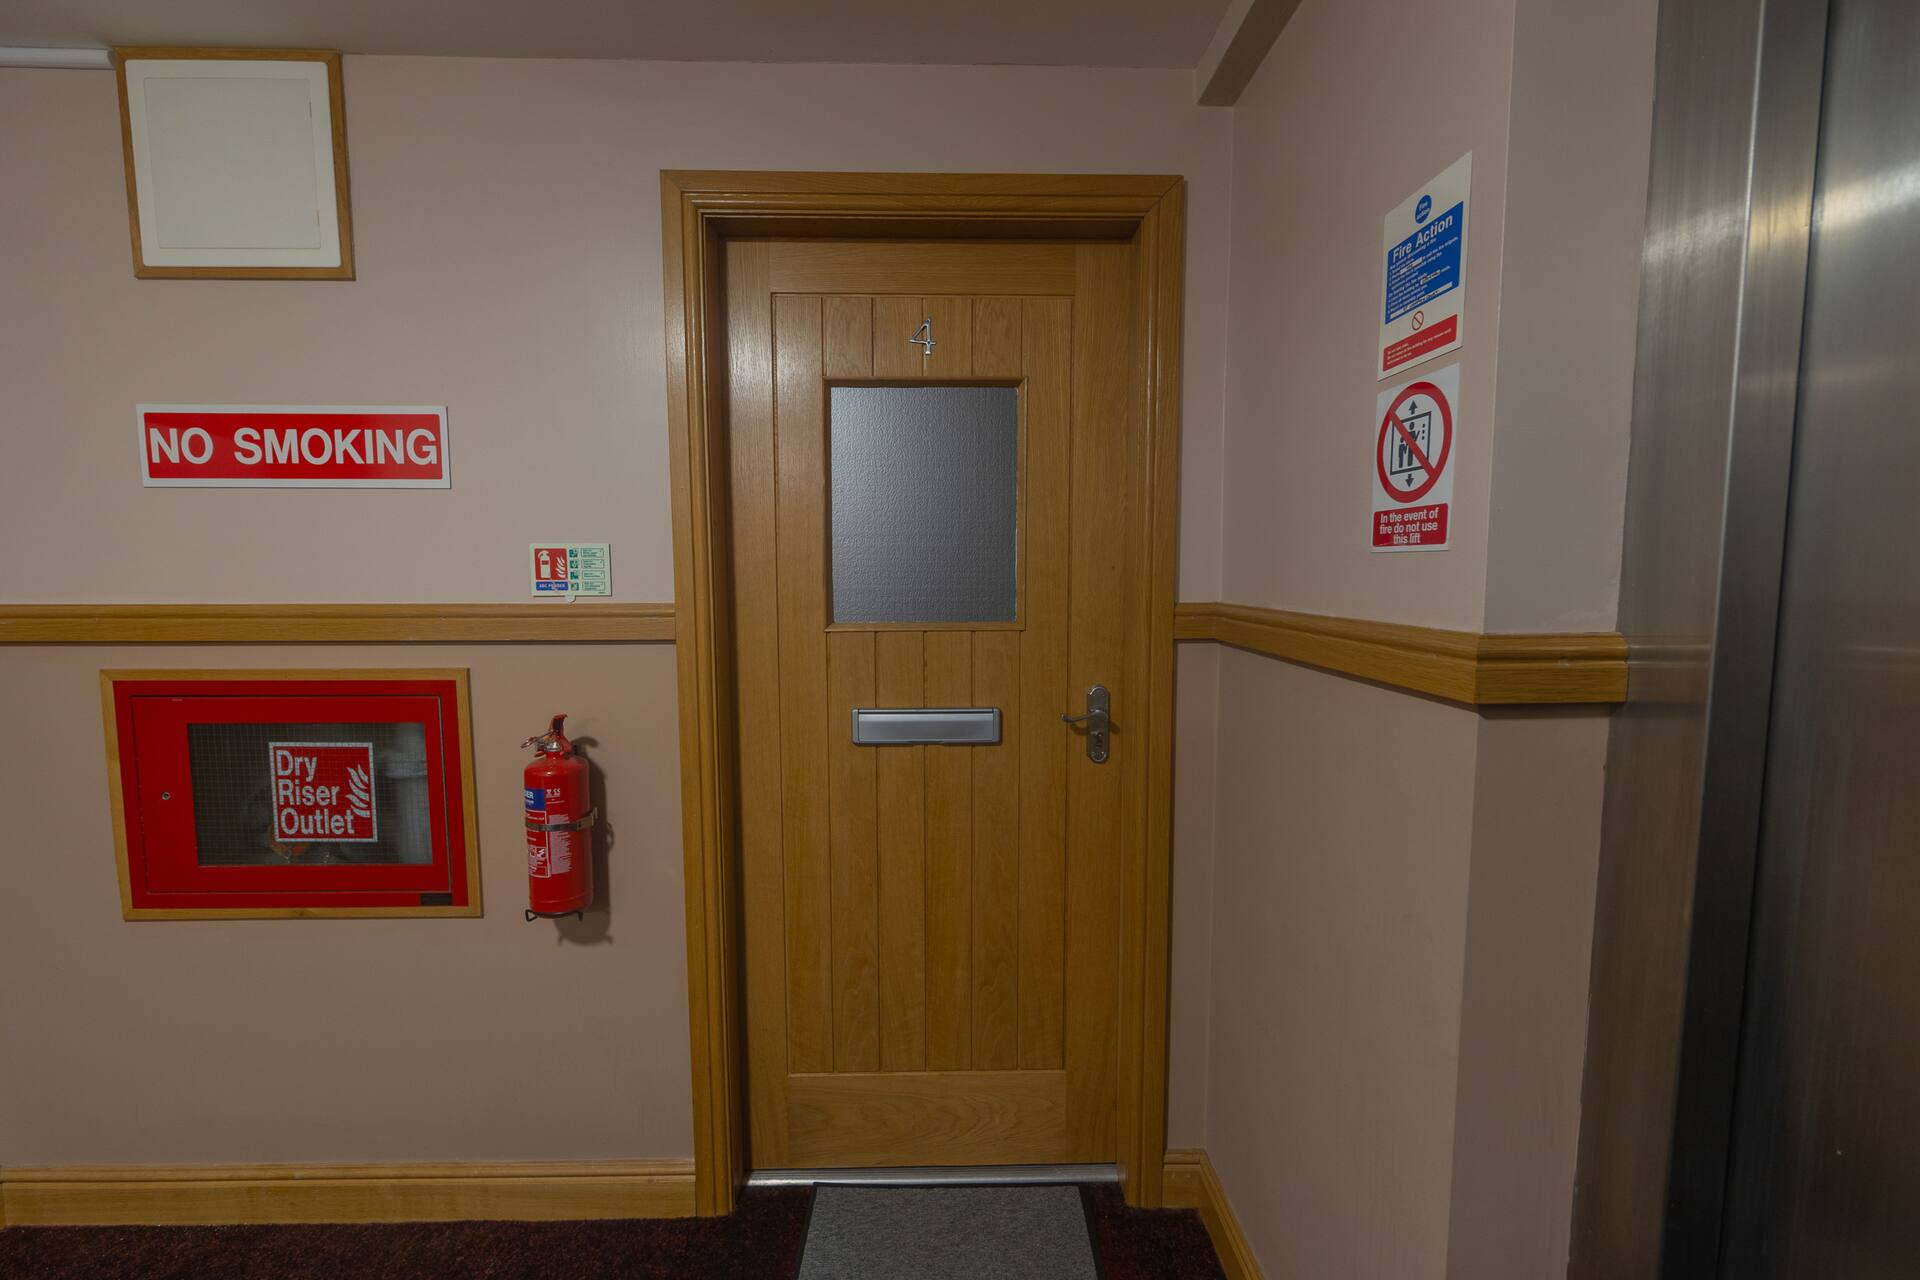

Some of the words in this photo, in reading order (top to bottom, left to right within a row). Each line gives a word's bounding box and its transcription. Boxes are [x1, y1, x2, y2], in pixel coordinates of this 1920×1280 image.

[1392, 242, 1412, 263] Fire
[1415, 215, 1453, 248] Action
[909, 318, 936, 355] 4
[149, 427, 214, 465] NO
[233, 427, 438, 465] SMOKING
[1380, 513, 1388, 524] In
[1389, 512, 1402, 523] the
[1403, 509, 1427, 521] event
[1428, 507, 1440, 519] of
[1380, 524, 1393, 535] fire
[1393, 523, 1405, 534] do
[1405, 521, 1421, 532] not
[1421, 522, 1438, 532] use
[1393, 533, 1408, 545] this
[1409, 532, 1421, 544] lift
[276, 750, 317, 782] Dry
[278, 779, 340, 806] Riser
[280, 807, 355, 835] Outlet
